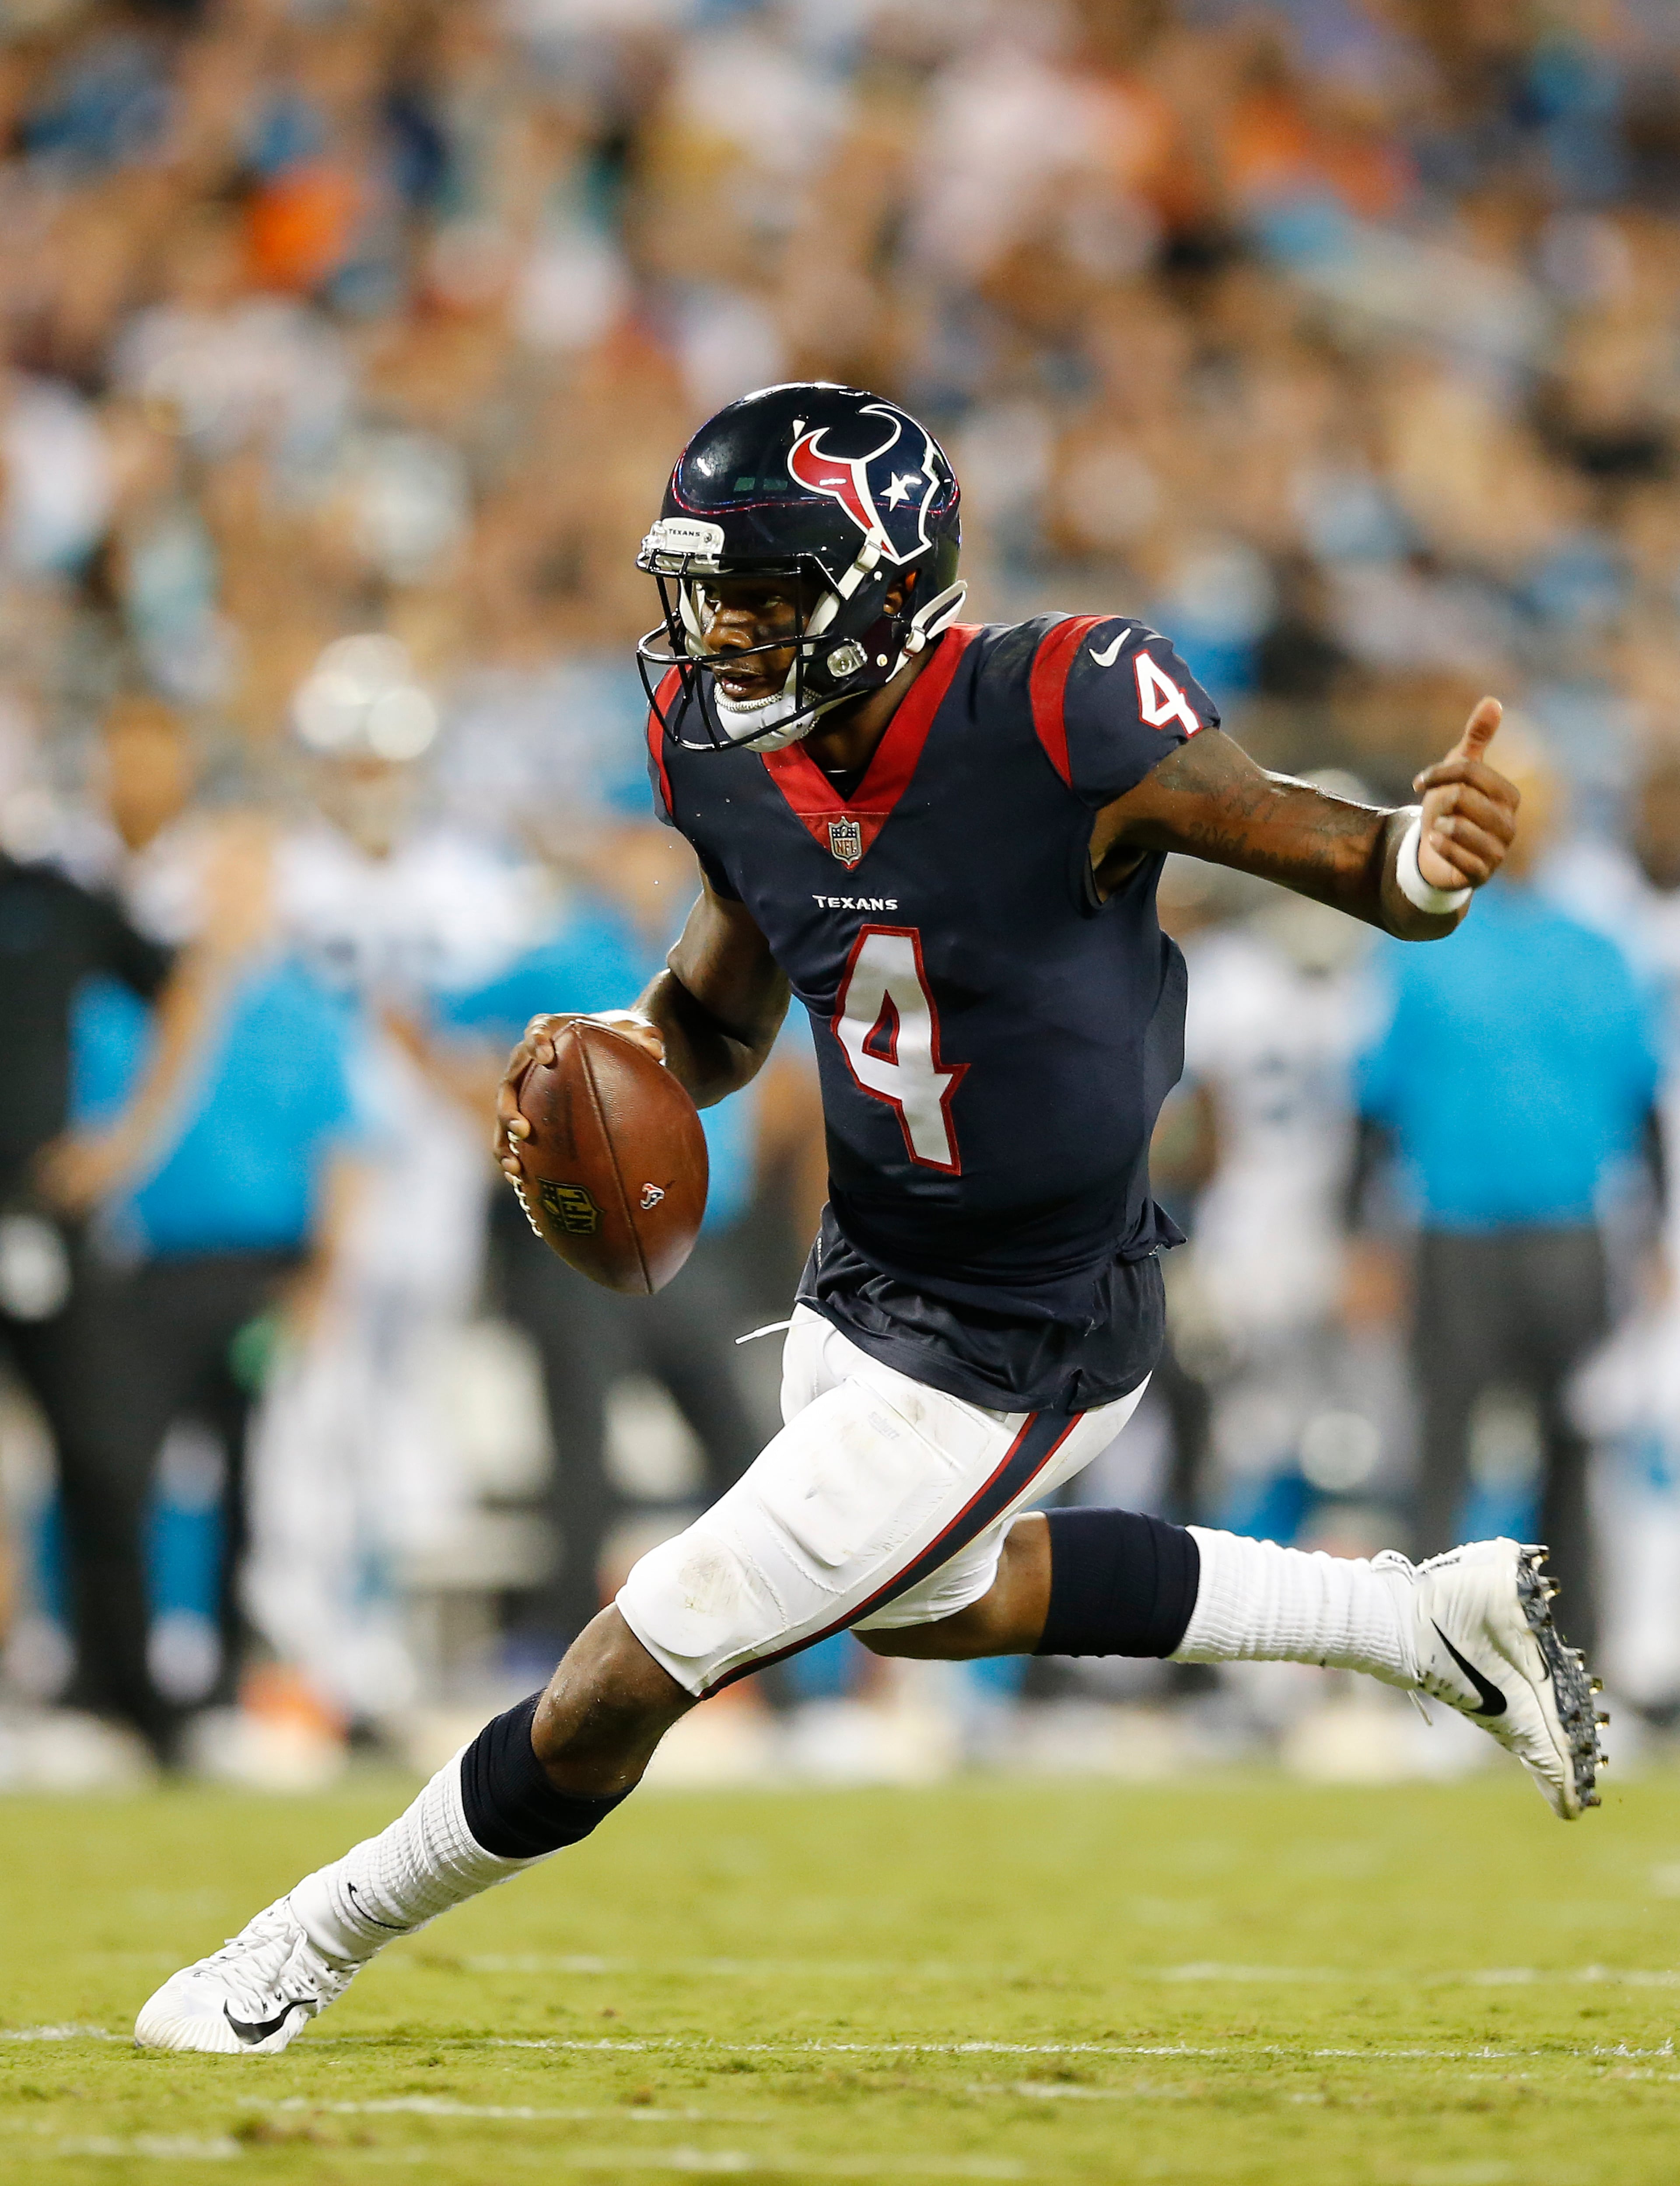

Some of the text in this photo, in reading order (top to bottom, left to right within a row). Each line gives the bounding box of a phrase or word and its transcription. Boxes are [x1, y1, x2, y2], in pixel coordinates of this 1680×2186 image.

[668, 528, 700, 537] TEXANS
[1133, 649, 1203, 739] 4
[835, 840, 857, 855] NFL
[812, 895, 898, 911] TEXANS
[830, 924, 971, 1176] 4
[560, 1190, 593, 1231] NFL
